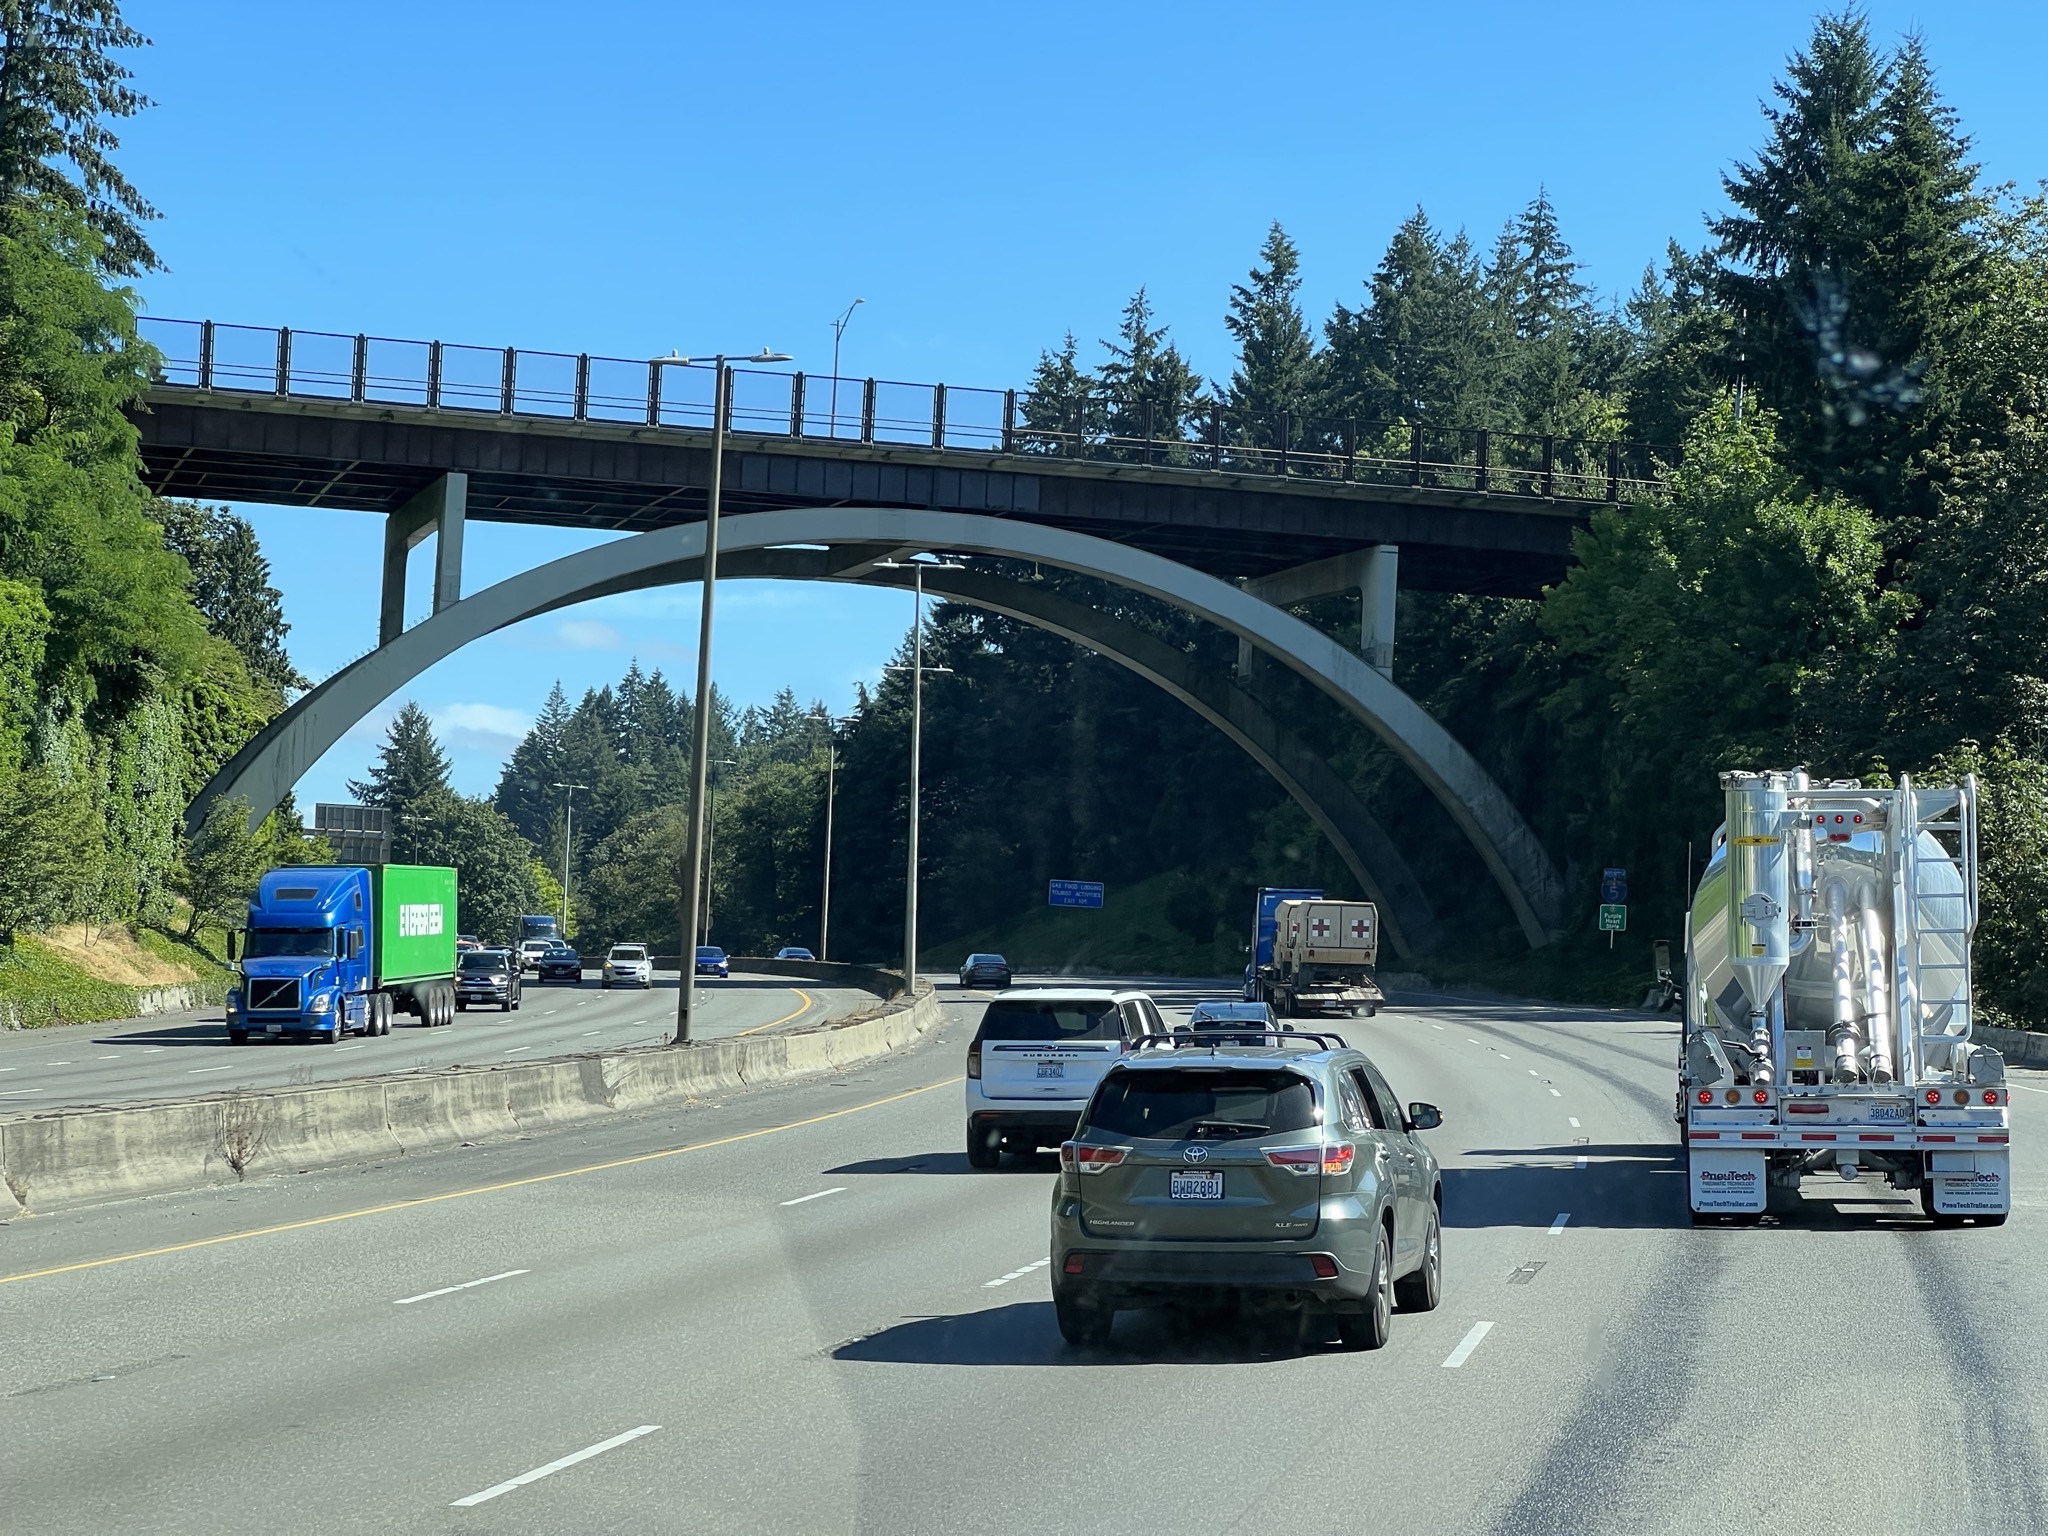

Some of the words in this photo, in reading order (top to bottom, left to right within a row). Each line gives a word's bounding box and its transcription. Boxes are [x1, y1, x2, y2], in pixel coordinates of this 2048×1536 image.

[1604, 870, 1625, 878] NORTH
[1610, 886, 1619, 899] 5
[400, 903, 443, 937] EVERGREEN
[1604, 912, 1622, 920] Purple
[1701, 1171, 1756, 1181] PneuTech
